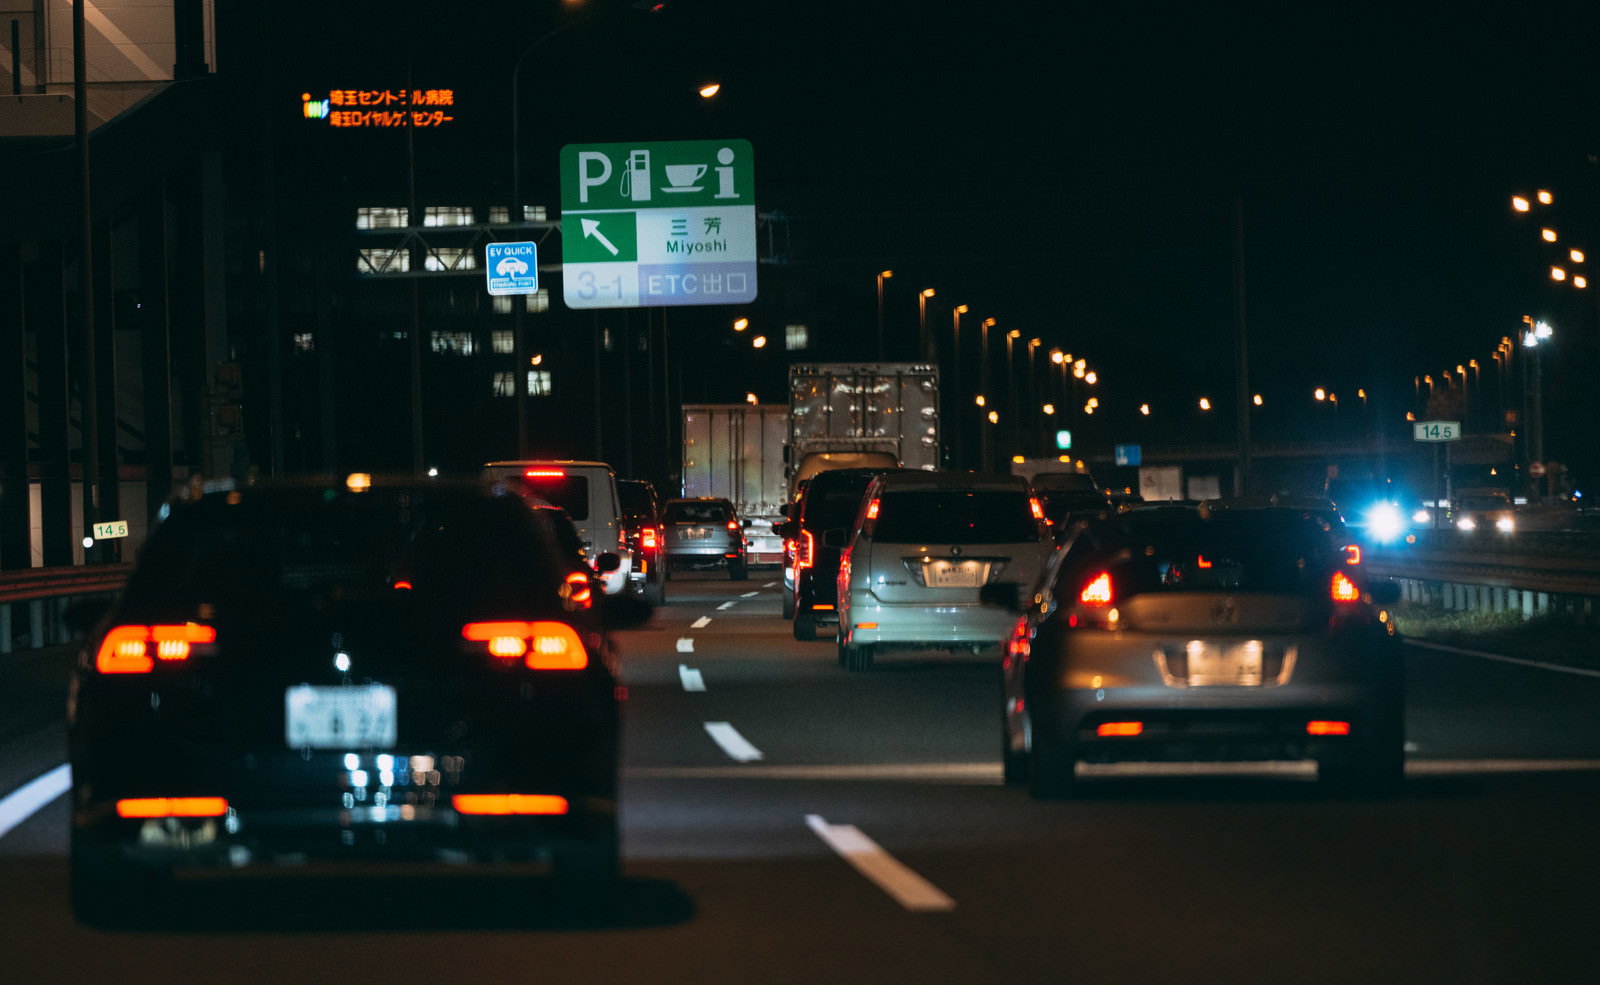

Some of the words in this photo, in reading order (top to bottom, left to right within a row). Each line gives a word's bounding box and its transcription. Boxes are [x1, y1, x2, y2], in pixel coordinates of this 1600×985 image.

[578, 151, 612, 203] P
[671, 217, 722, 235] 三芳
[490, 247, 502, 257] EV
[504, 246, 533, 256] QUICK
[666, 239, 727, 255] Miyoshi
[577, 270, 623, 301] 3-1
[1423, 424, 1452, 439] 14.5
[97, 524, 126, 537] 14.5
